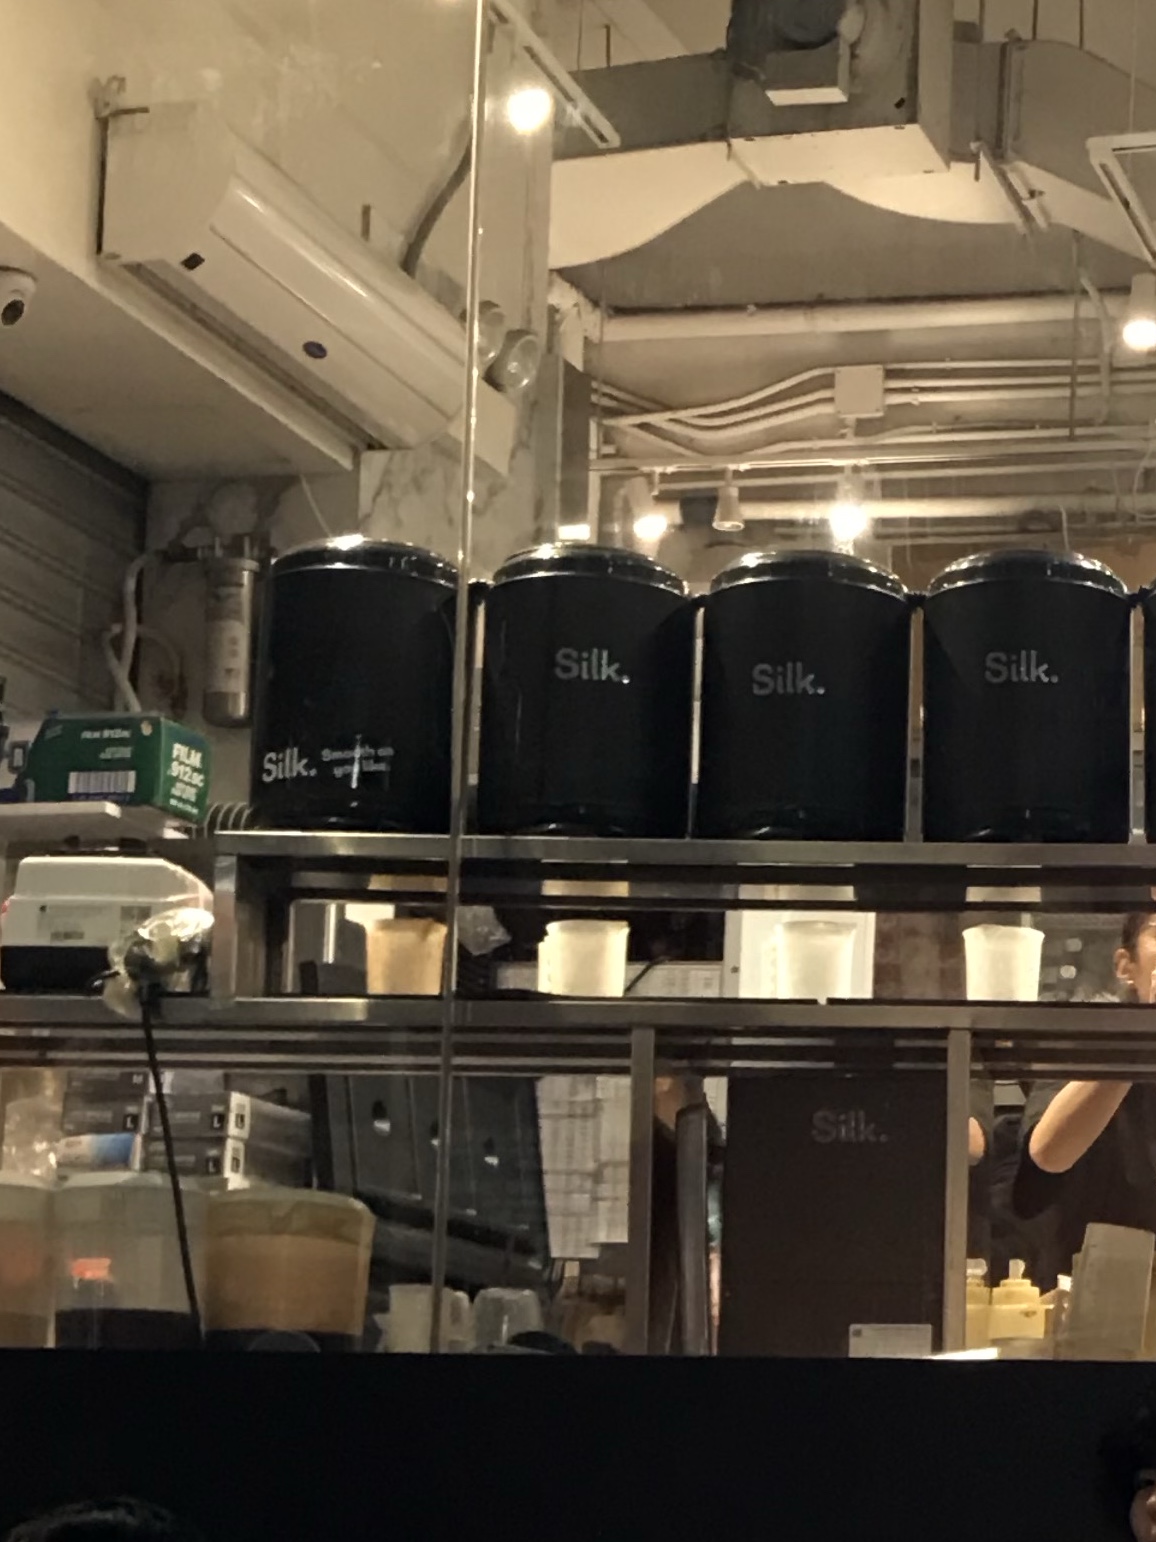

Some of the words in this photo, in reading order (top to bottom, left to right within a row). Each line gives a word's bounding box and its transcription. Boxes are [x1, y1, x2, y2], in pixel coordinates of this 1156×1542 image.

[553, 648, 631, 685] Silk.
[752, 661, 826, 697] Silk.
[984, 650, 1060, 685] Silk.
[172, 743, 203, 768] FILM
[262, 747, 317, 782] Silk.
[811, 1110, 889, 1144] Silk.
